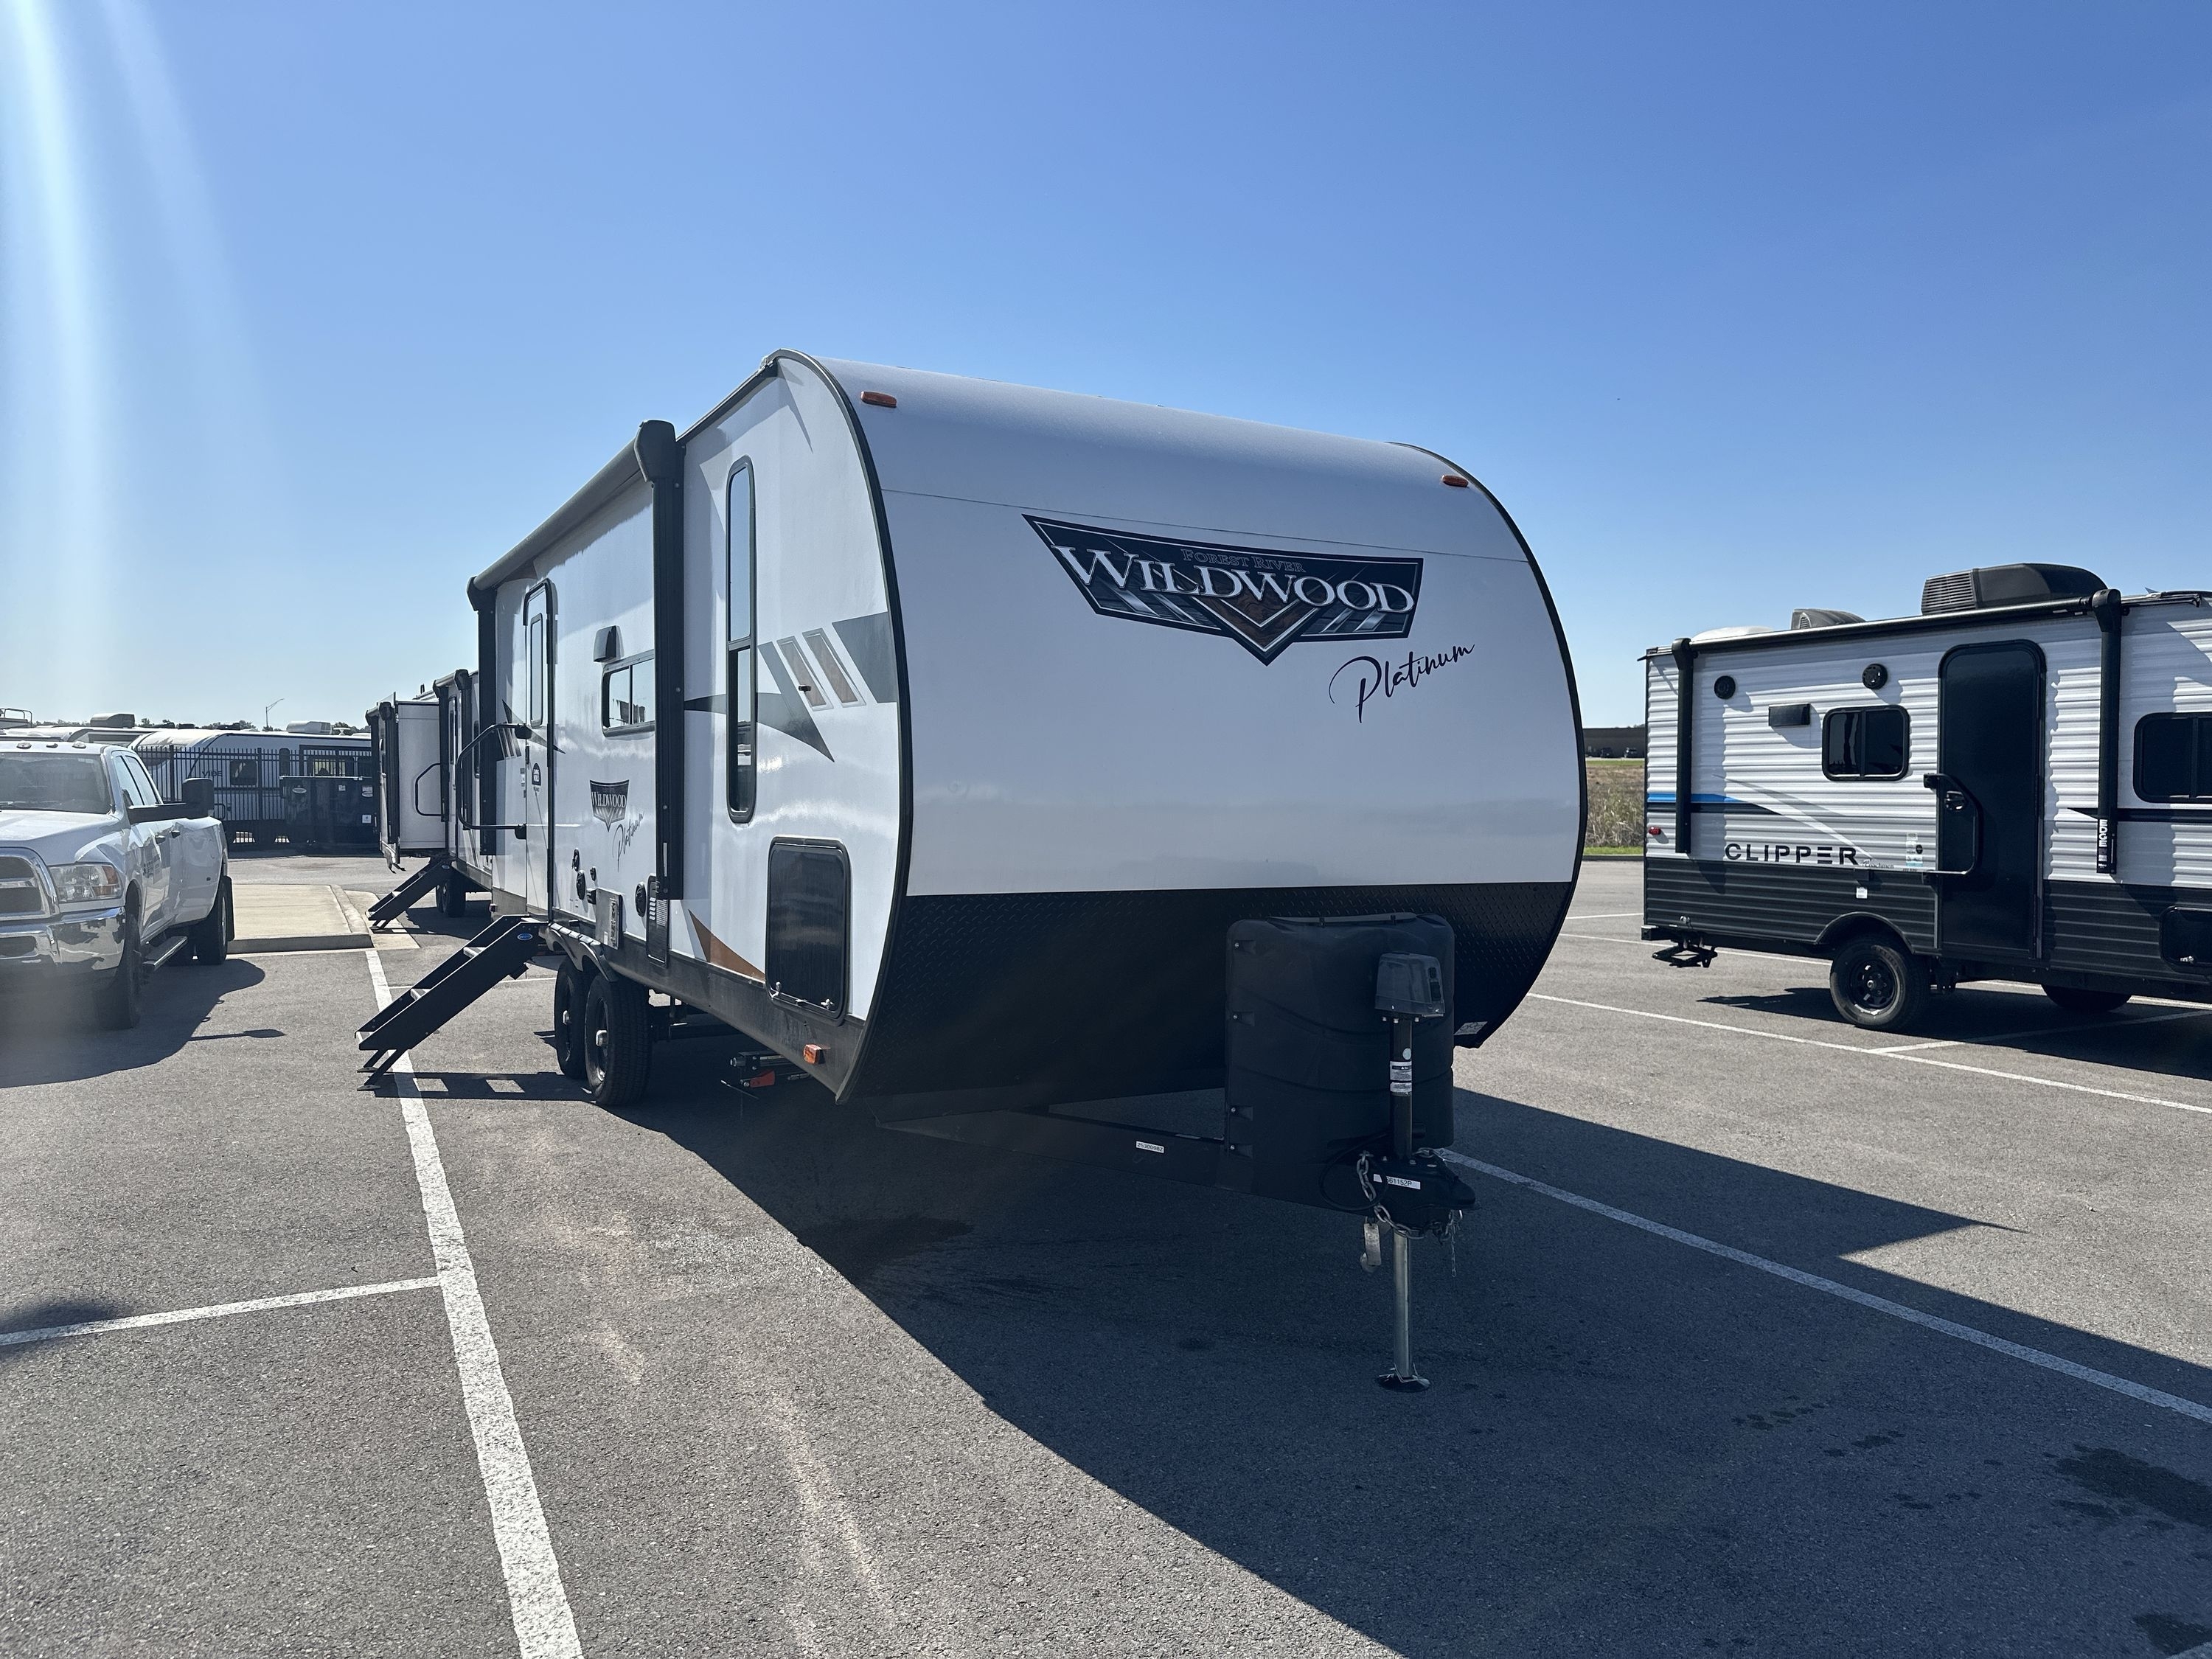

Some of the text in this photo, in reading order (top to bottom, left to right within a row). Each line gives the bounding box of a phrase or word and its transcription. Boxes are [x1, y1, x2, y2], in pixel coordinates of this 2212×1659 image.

[1180, 548, 1307, 573] FOREST RIVER
[1050, 545, 1415, 613] WILDWOOD
[1329, 644, 1475, 723] Platinum
[591, 791, 627, 808] WILDWOOD
[2098, 818, 2108, 847] EDGE
[1724, 843, 1859, 866] CLIPPER
